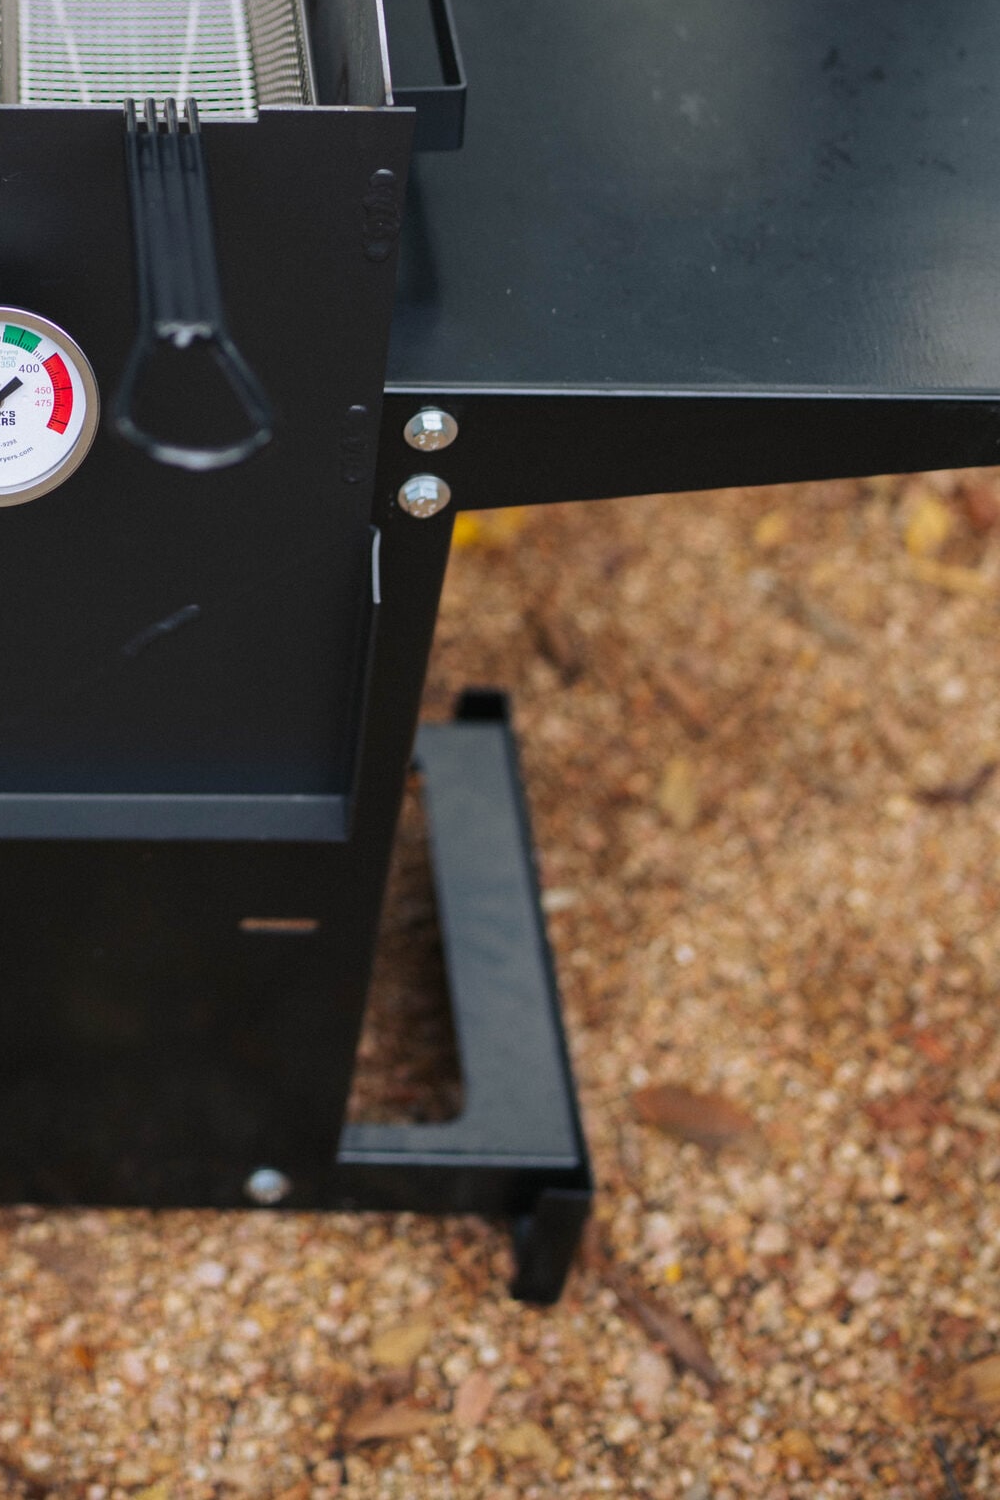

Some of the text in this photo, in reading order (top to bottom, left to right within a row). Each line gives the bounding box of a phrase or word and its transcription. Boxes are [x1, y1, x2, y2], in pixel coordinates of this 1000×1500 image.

[1, 360, 16, 368] 350
[18, 364, 40, 373] 400
[34, 386, 52, 395] 450
[34, 399, 52, 407] 475
